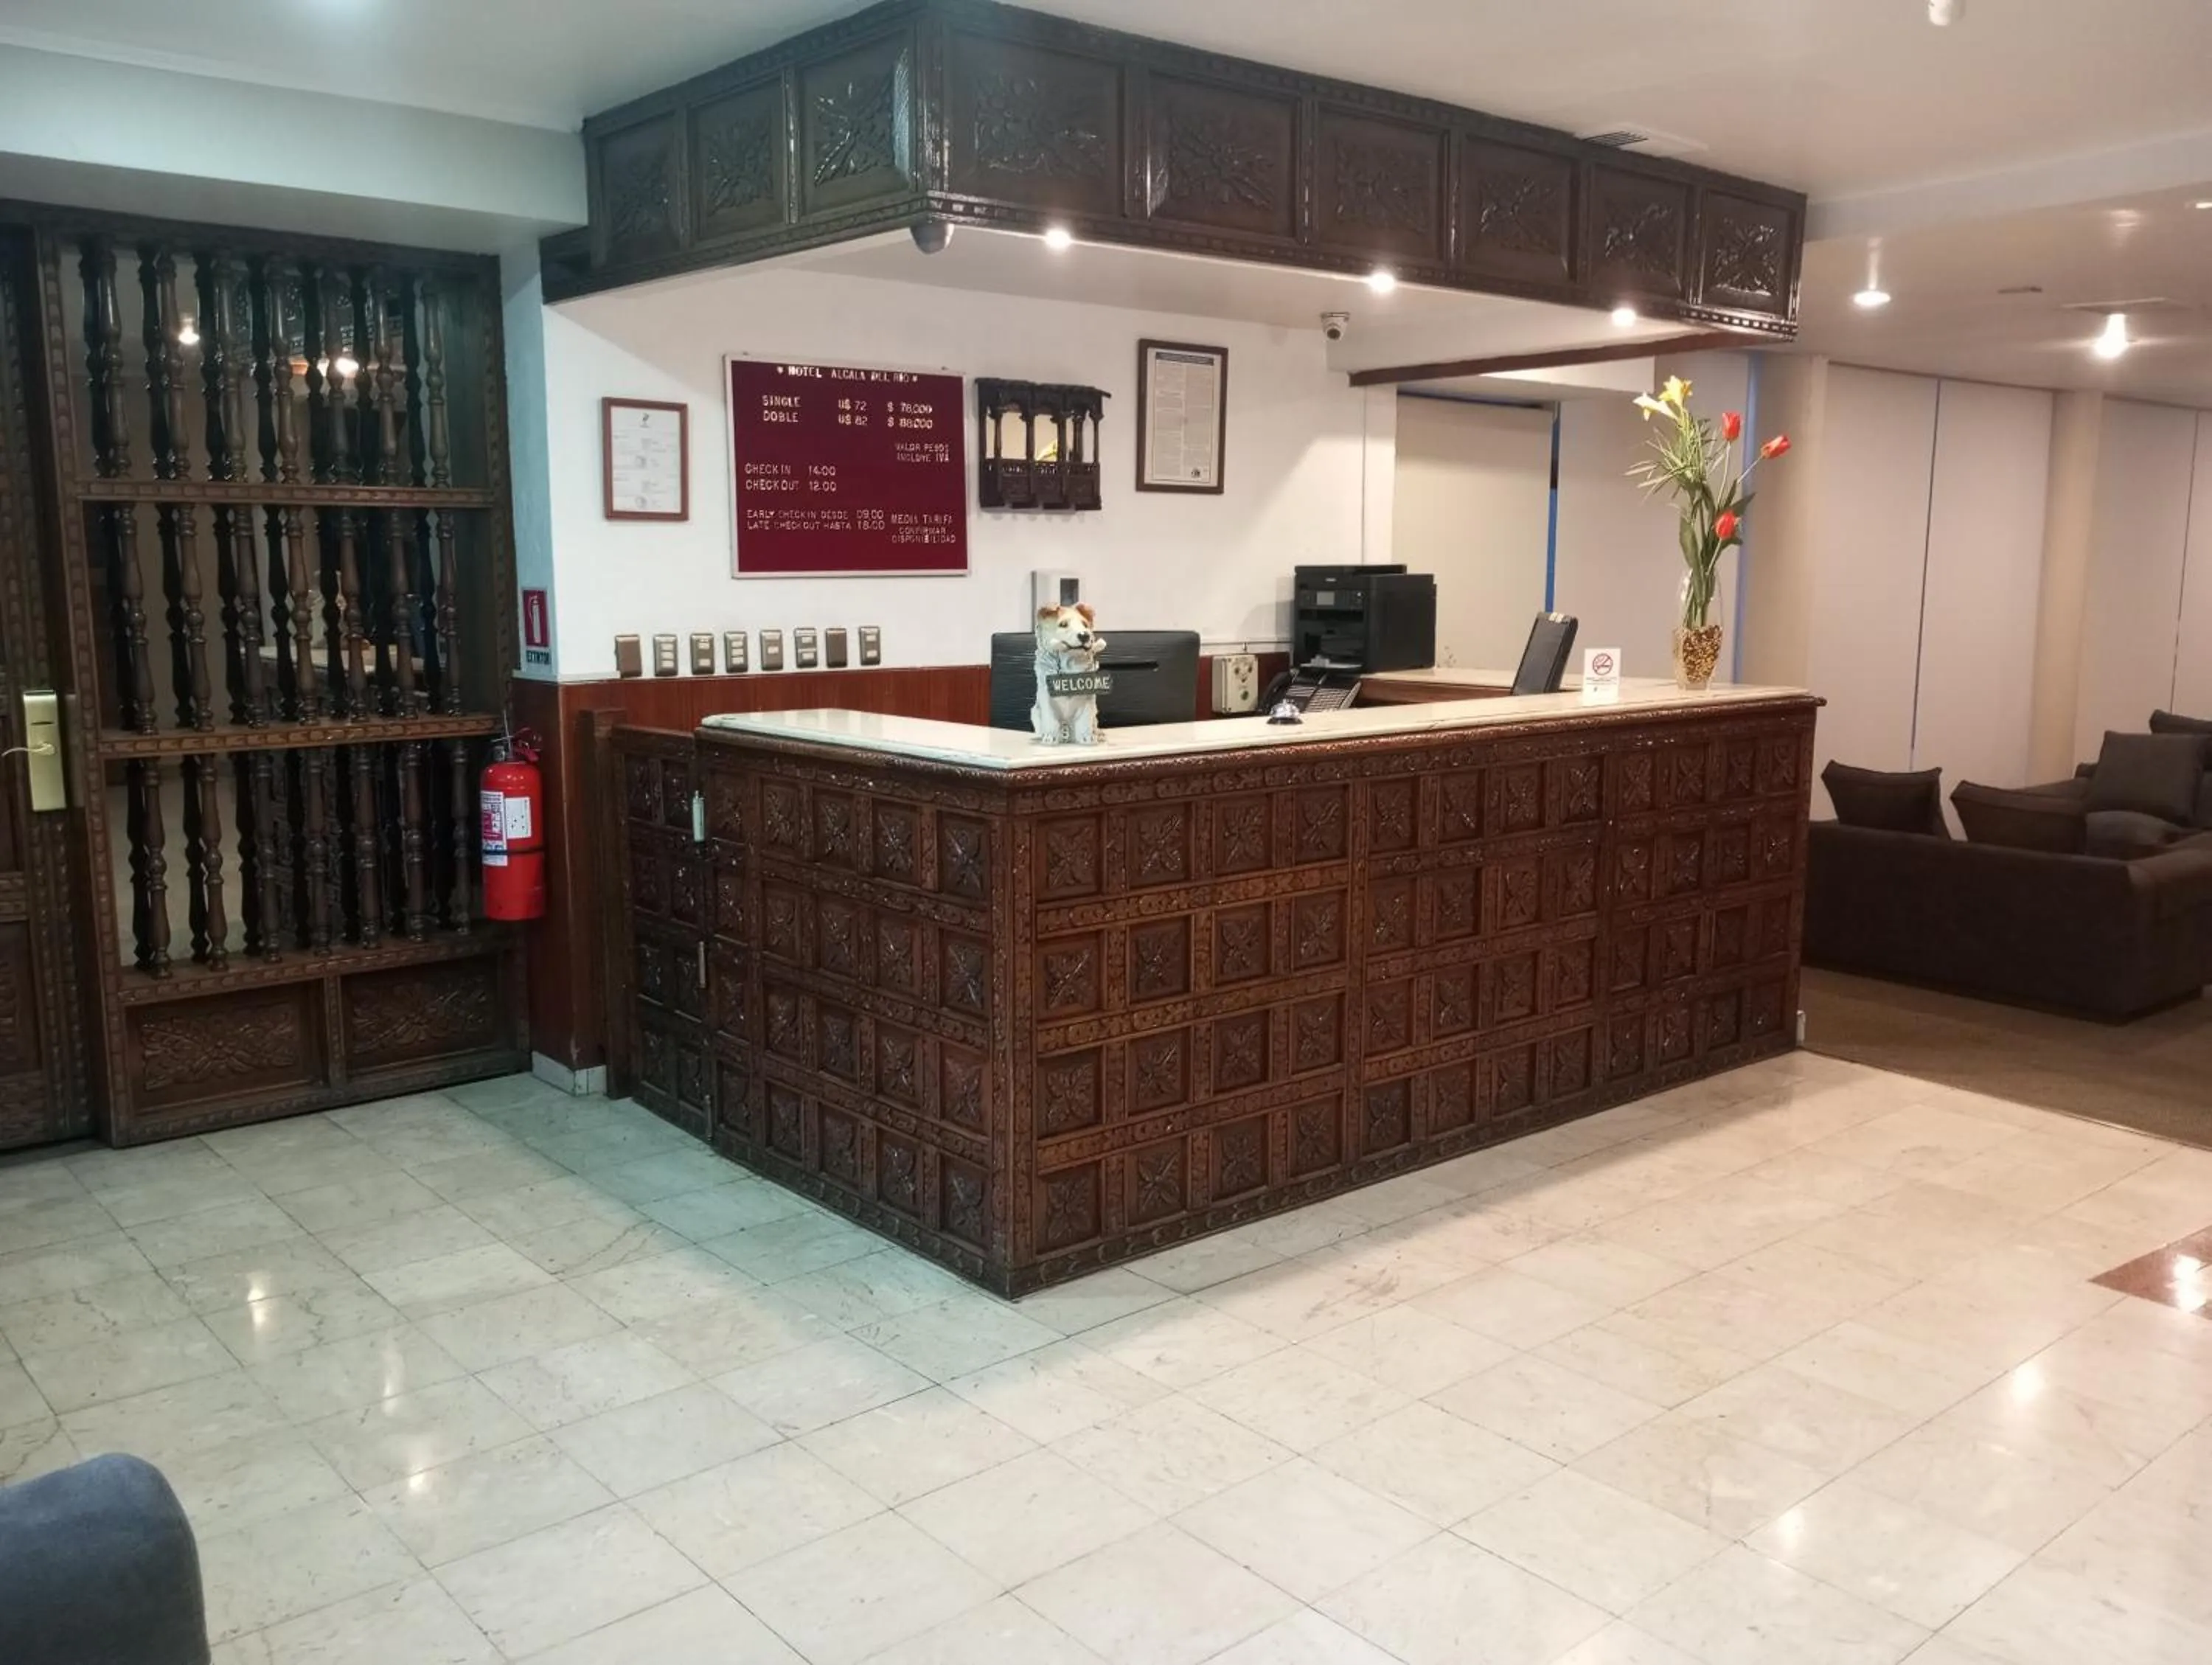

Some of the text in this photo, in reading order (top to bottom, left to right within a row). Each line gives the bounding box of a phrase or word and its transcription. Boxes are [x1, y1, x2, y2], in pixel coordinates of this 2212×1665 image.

[788, 365, 822, 378] HOTEL
[762, 394, 801, 408] SINGLE
[855, 400, 867, 411] 72
[763, 410, 799, 423] DOBLE
[747, 520, 770, 530] LATE
[1052, 676, 1110, 692] WELCOME
